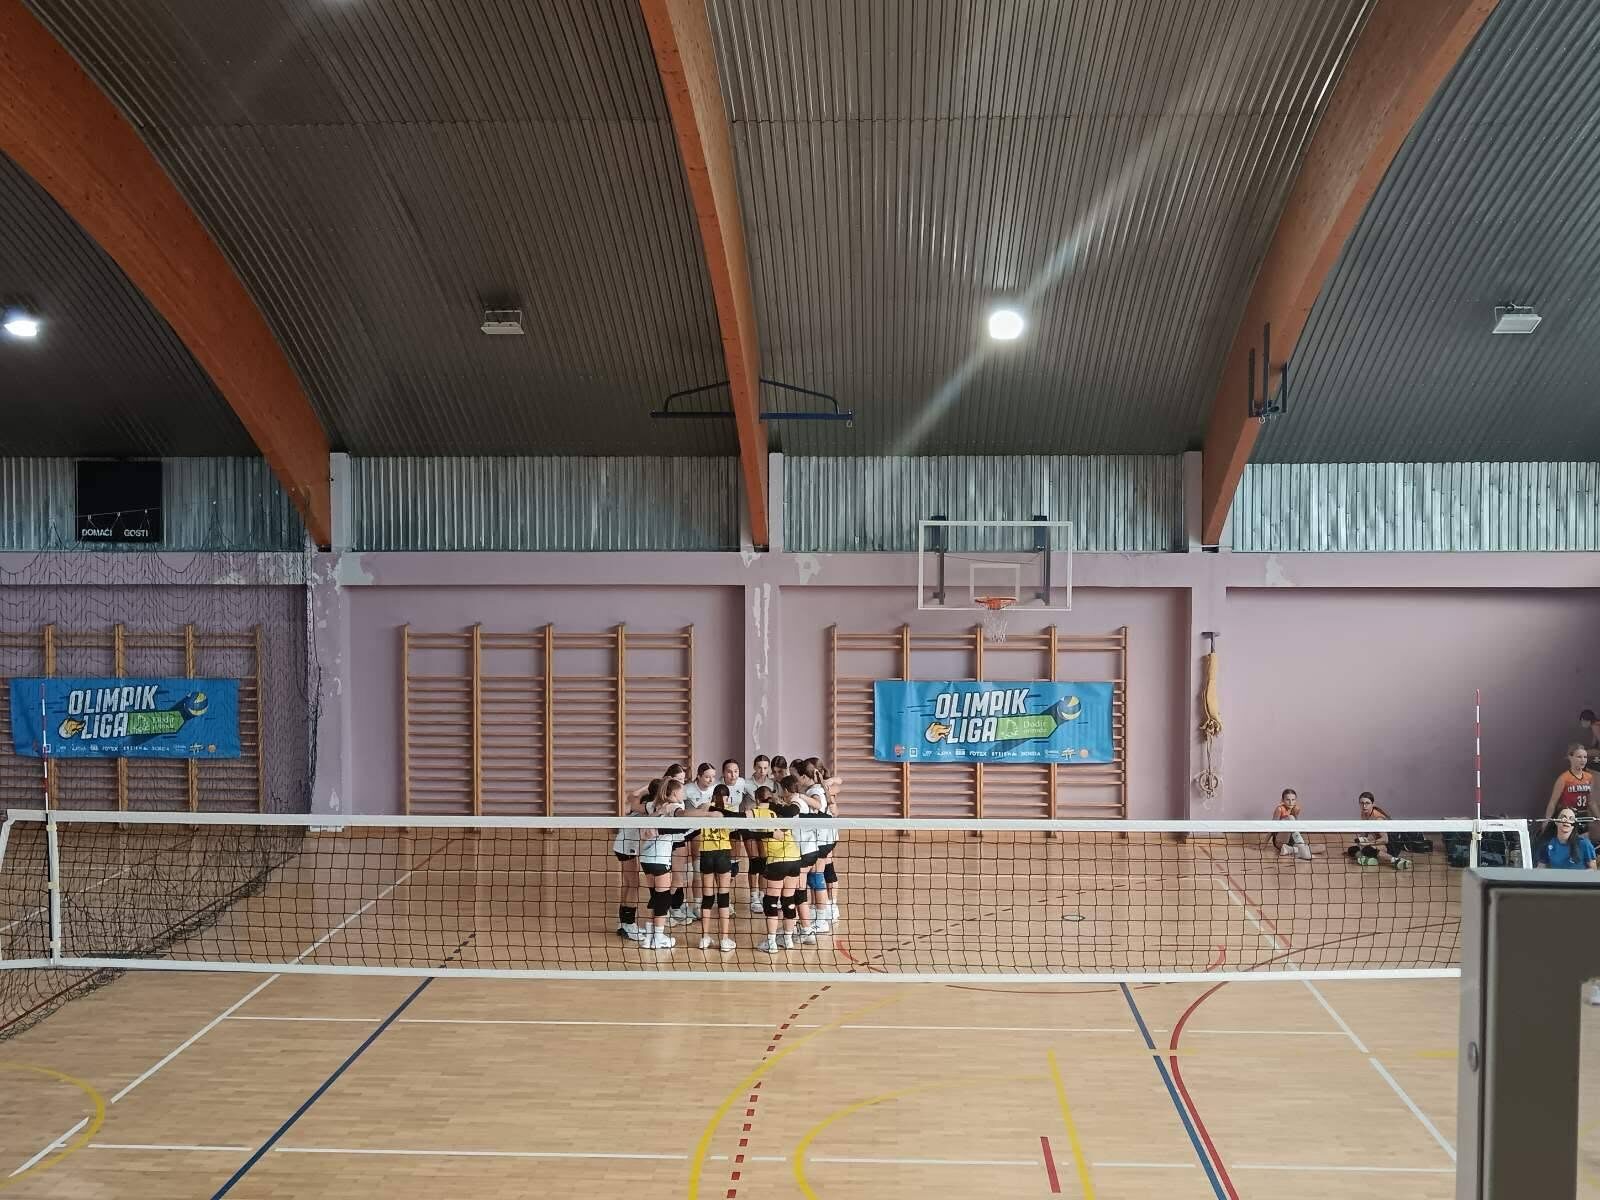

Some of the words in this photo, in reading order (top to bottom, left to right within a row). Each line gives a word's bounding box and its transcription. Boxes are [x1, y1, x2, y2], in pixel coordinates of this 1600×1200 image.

[68, 685, 159, 715] OLIMPIK
[934, 689, 1030, 719] OLIMPIK
[80, 711, 129, 740] LIGA
[946, 716, 998, 744] LIGA
[1576, 795, 1587, 807] 32
